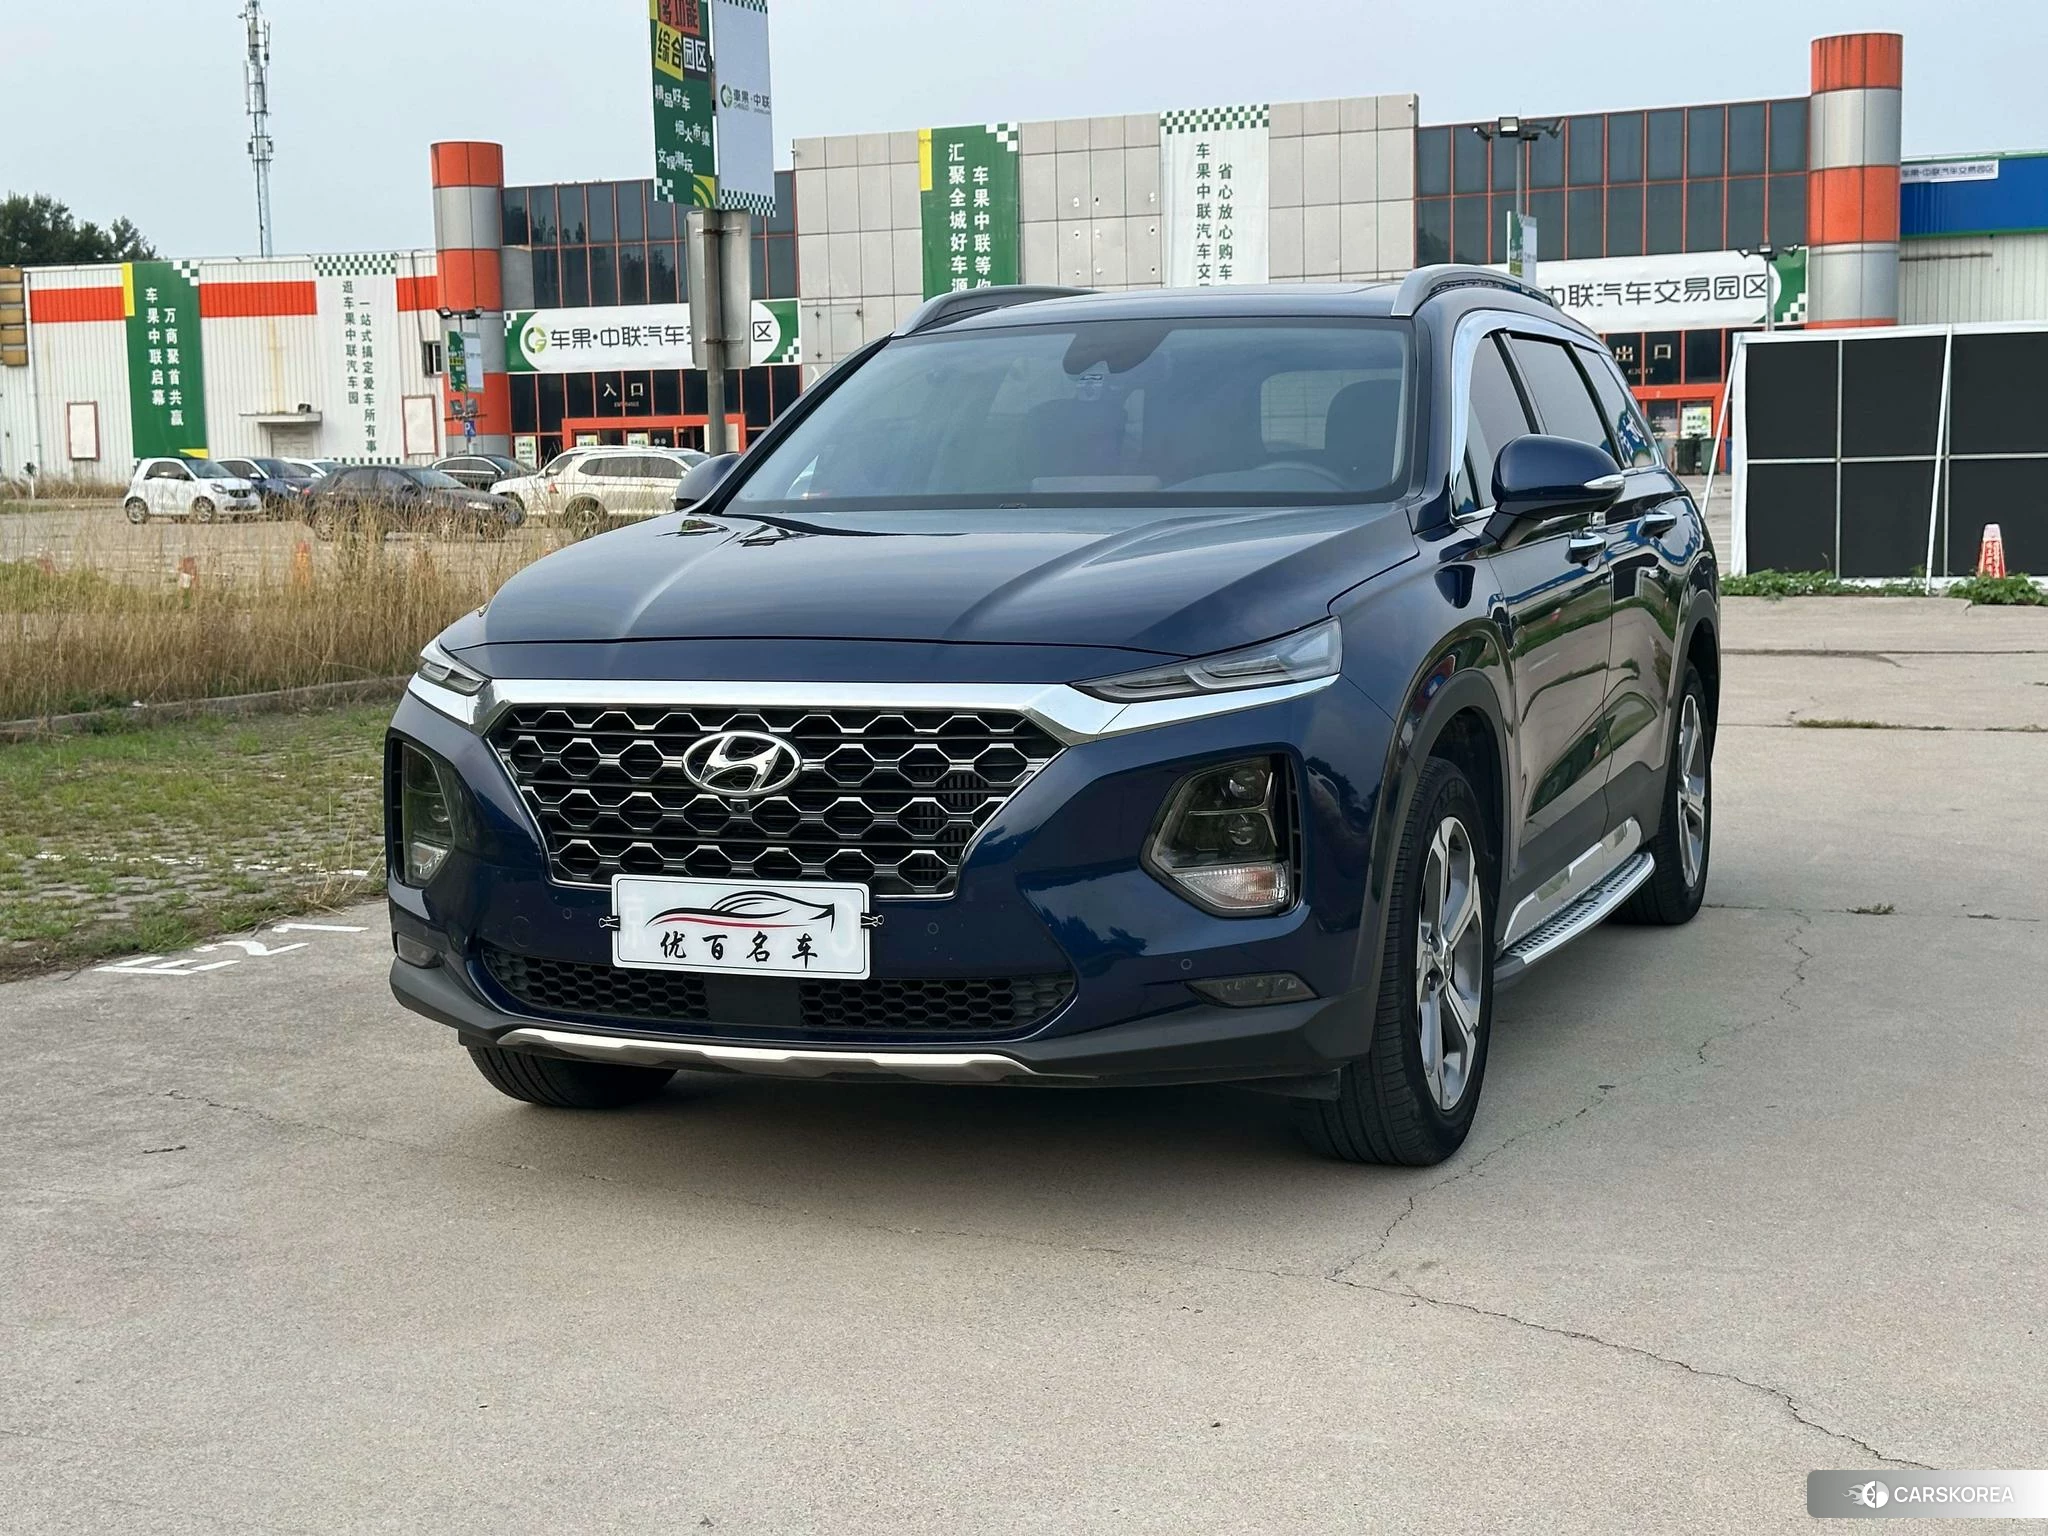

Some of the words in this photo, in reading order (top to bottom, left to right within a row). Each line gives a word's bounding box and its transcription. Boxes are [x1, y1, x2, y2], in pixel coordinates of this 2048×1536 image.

[655, 85, 691, 112] 精品好车
[658, 28, 707, 73] 综合园区
[675, 120, 710, 147] 烟火市集
[948, 143, 968, 292] 汇聚全城好车源
[1196, 142, 1211, 286] 车果中联汽车交
[1218, 163, 1233, 280] 省心放心购车
[145, 287, 165, 406] 车果中联启幕
[164, 307, 184, 426] 万商聚首共赢
[342, 281, 359, 405] 逛车果中联汽车园
[359, 301, 377, 453] 一站式搞定爱车所有事
[603, 382, 644, 398] 入口
[1615, 344, 1672, 362] 出口
[660, 931, 818, 969] 优百名车
